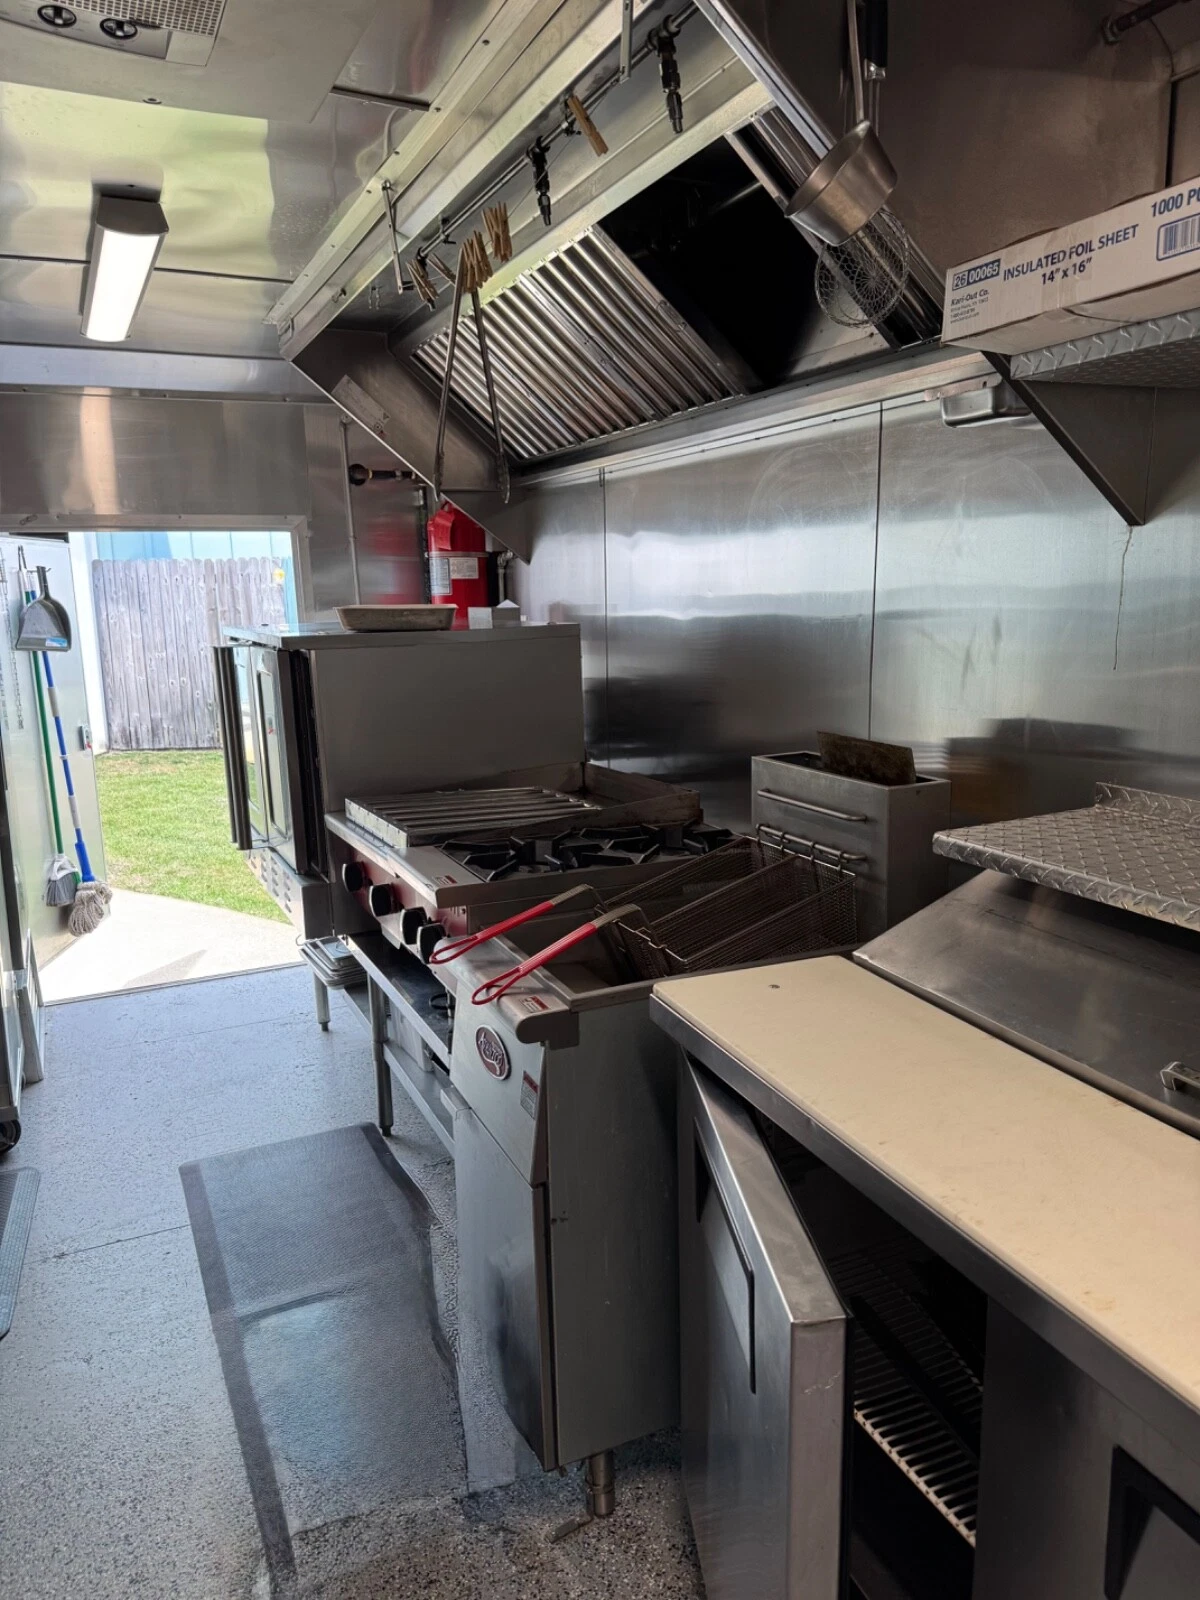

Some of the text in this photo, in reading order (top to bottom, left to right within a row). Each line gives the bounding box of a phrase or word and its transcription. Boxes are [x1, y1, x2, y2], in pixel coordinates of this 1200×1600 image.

[1151, 193, 1184, 218] 1000
[1003, 250, 1067, 282] INSULATED
[1068, 239, 1095, 260] FOIL
[1097, 223, 1139, 250] SHEET
[954, 261, 999, 288] 26 00065
[1061, 267, 1069, 279] x
